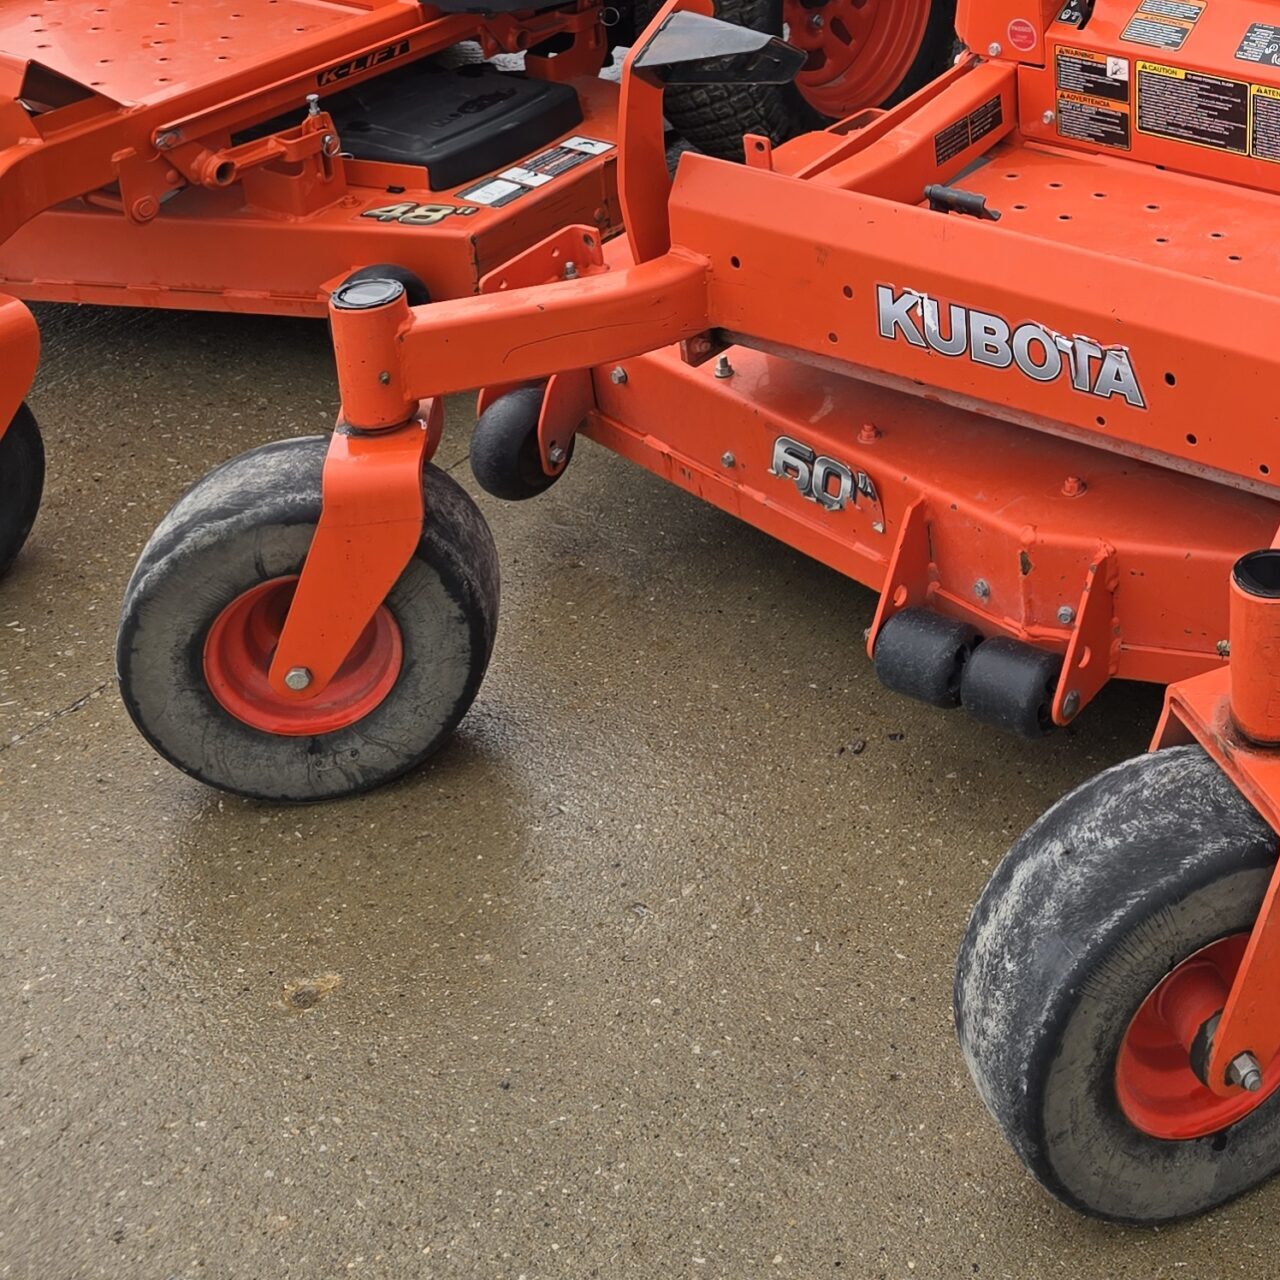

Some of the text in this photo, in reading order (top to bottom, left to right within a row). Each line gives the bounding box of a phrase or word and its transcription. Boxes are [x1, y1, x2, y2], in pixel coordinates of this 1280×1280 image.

[1064, 48, 1095, 60] WARNING
[320, 40, 408, 86] K-LIFT
[1147, 64, 1178, 76] CAUTION
[1066, 93, 1111, 108] ADVERTENCIA
[875, 283, 1147, 410] KUBOTA
